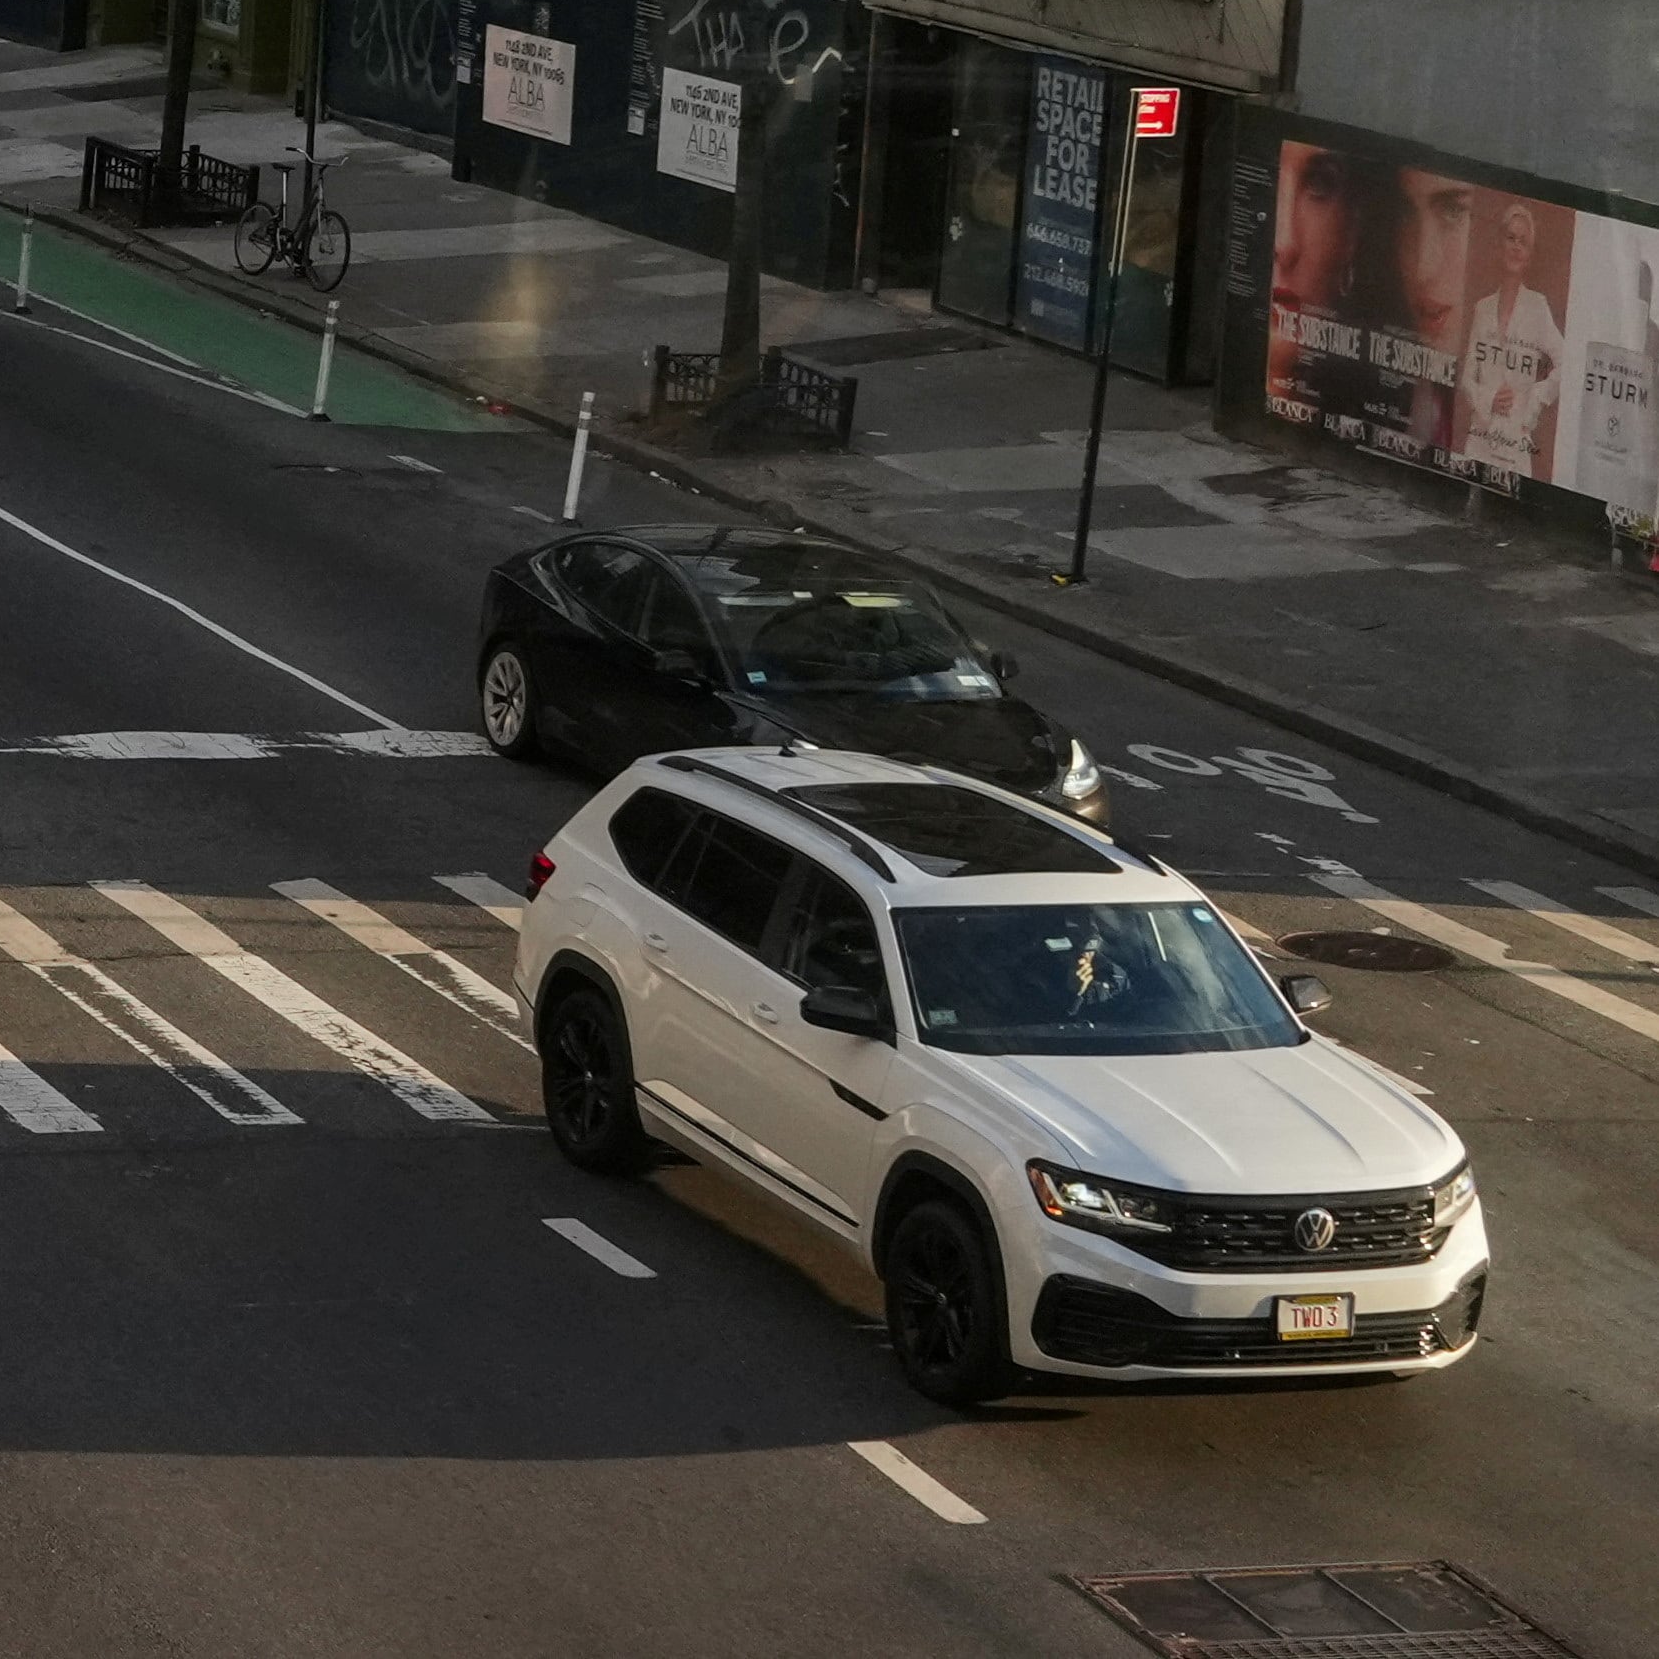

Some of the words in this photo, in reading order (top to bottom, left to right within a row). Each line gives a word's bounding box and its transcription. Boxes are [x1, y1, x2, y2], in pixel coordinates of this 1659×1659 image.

[508, 77, 545, 110] ALBA
[670, 98, 689, 115] NEW
[715, 109, 727, 125] NY
[687, 124, 728, 160] ALBA
[1037, 99, 1103, 147] SPACE
[1046, 134, 1089, 177] FOR
[1033, 163, 1099, 212] LEASE
[1273, 303, 1298, 344] THE
[1298, 313, 1362, 362] SUBSTANCE
[1369, 330, 1392, 368] THE
[1392, 339, 1458, 389] SUBSTANCE
[1585, 372, 1648, 409] STURM
